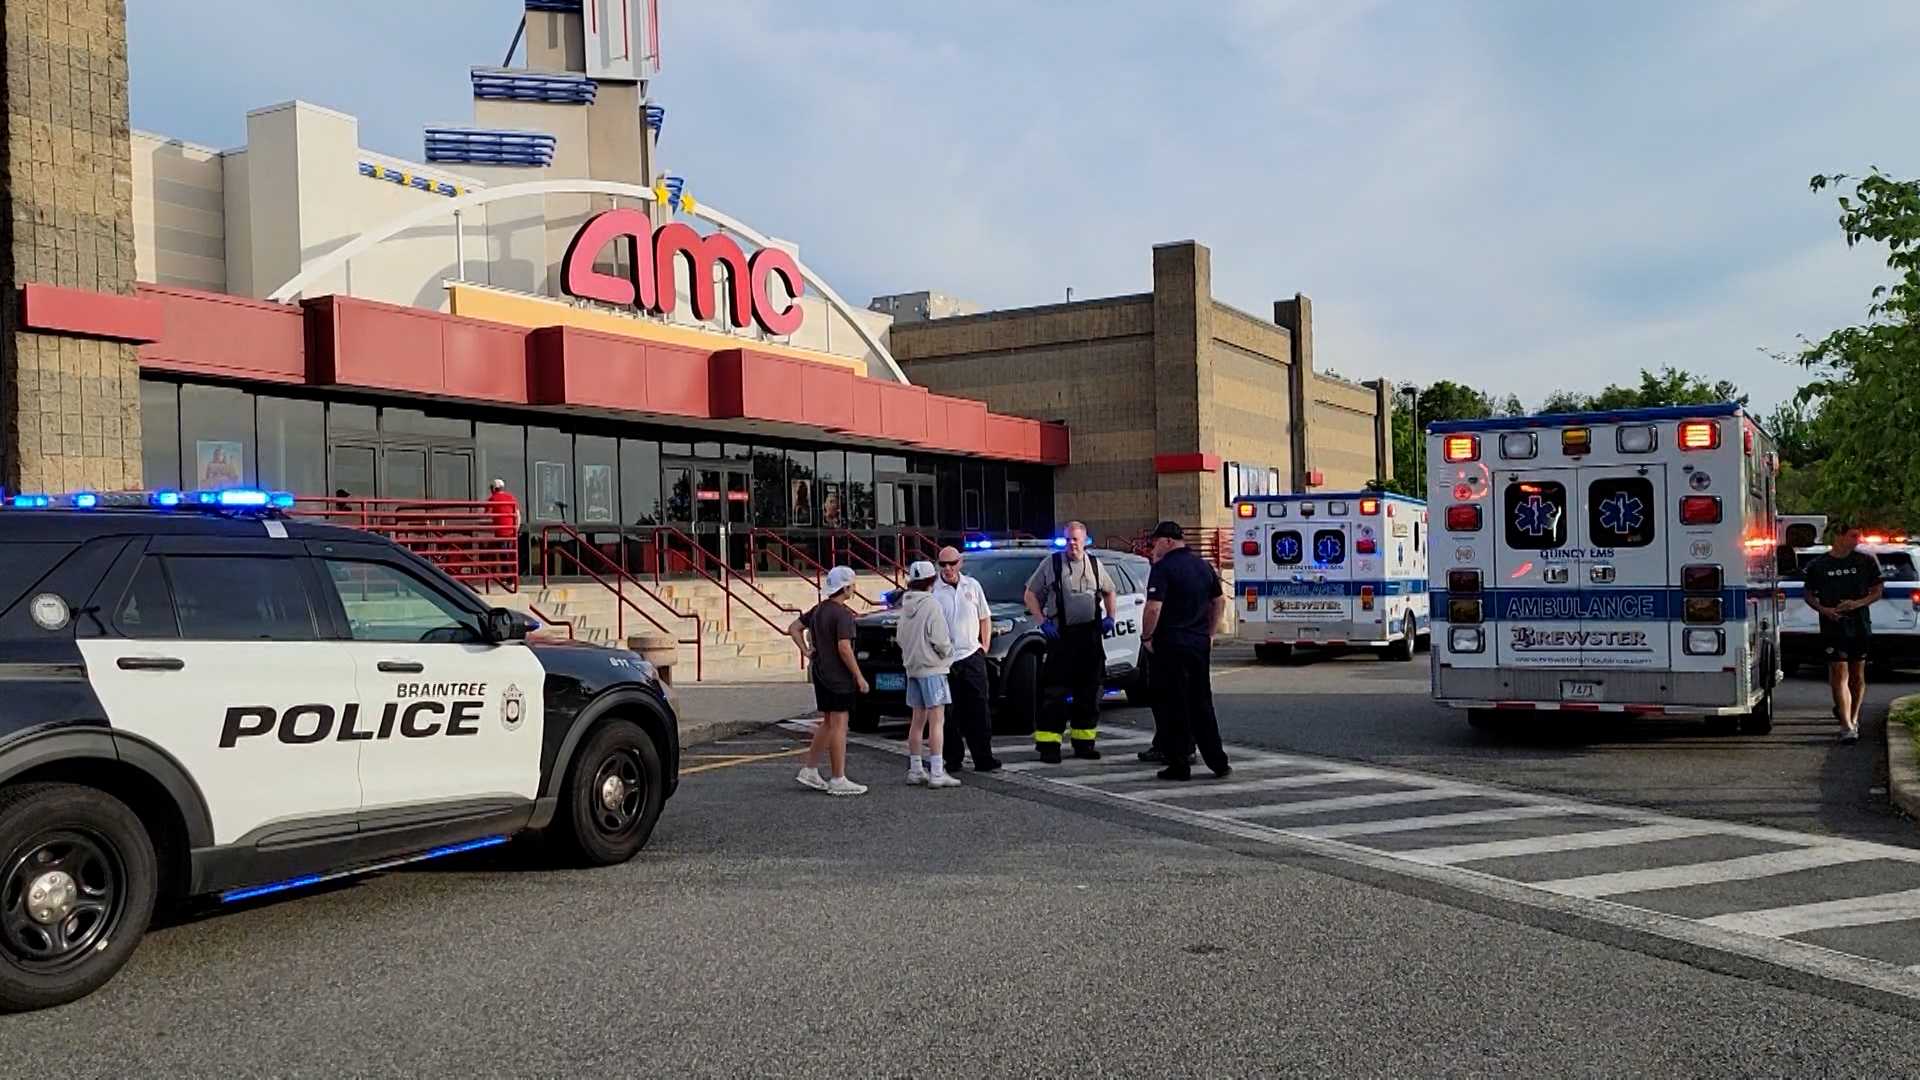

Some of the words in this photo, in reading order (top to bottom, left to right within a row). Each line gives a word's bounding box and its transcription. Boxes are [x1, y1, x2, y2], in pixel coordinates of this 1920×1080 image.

[1540, 549, 1585, 559] QUINCY
[1590, 548, 1615, 558] EMS
[1506, 595, 1655, 619] AMBULANCE
[1510, 625, 1648, 648] BREWSTER
[397, 682, 488, 698] BRAINTREE
[218, 700, 485, 748] POLICE
